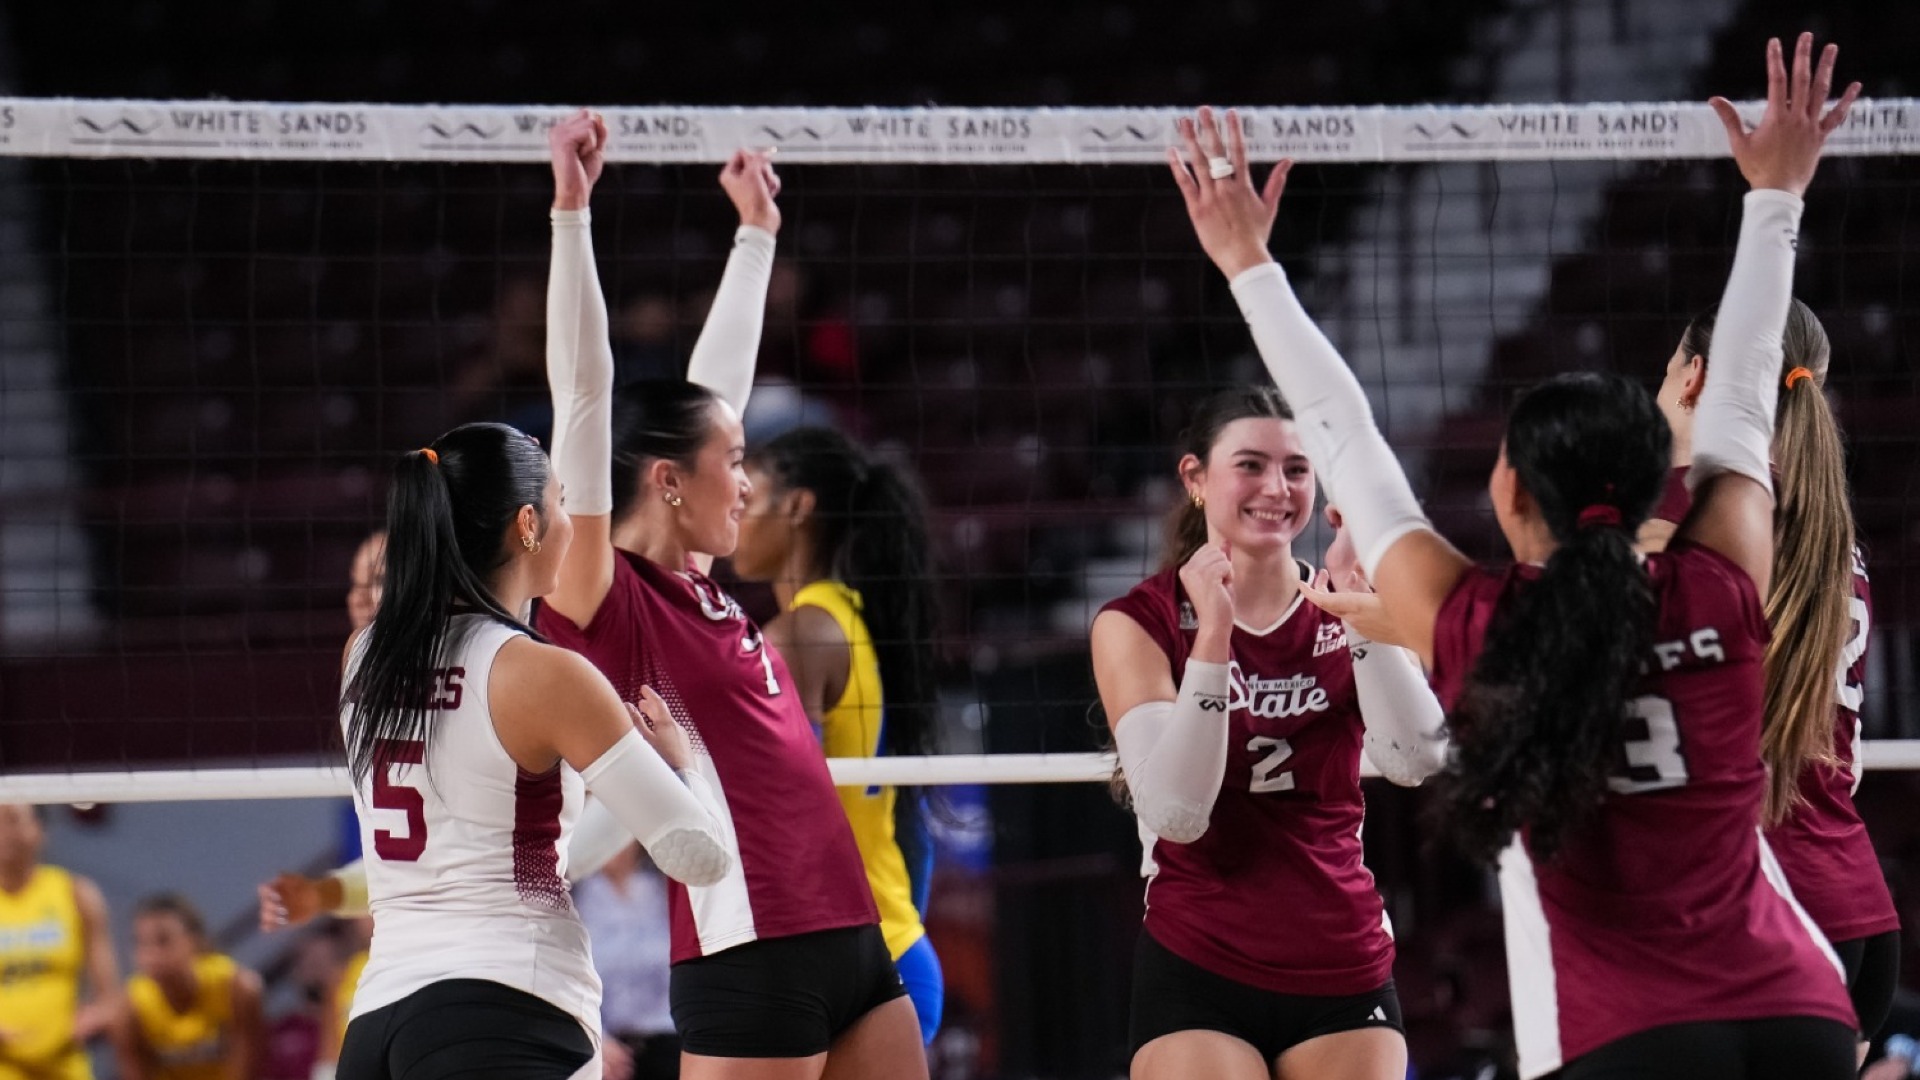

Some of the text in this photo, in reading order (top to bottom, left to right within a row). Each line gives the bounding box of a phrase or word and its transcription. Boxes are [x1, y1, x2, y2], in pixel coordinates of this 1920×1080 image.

[170, 110, 367, 135] WHITE SANDS
[618, 115, 703, 138] SANDS
[847, 116, 1032, 139] WHITE SANDS
[1272, 115, 1355, 138] SANDS
[1497, 112, 1679, 135] WHITE SANDS
[1840, 106, 1908, 129] HITE
[1273, 678, 1315, 690] MEXICO
[1246, 735, 1295, 793] 2
[372, 738, 428, 862] 5
